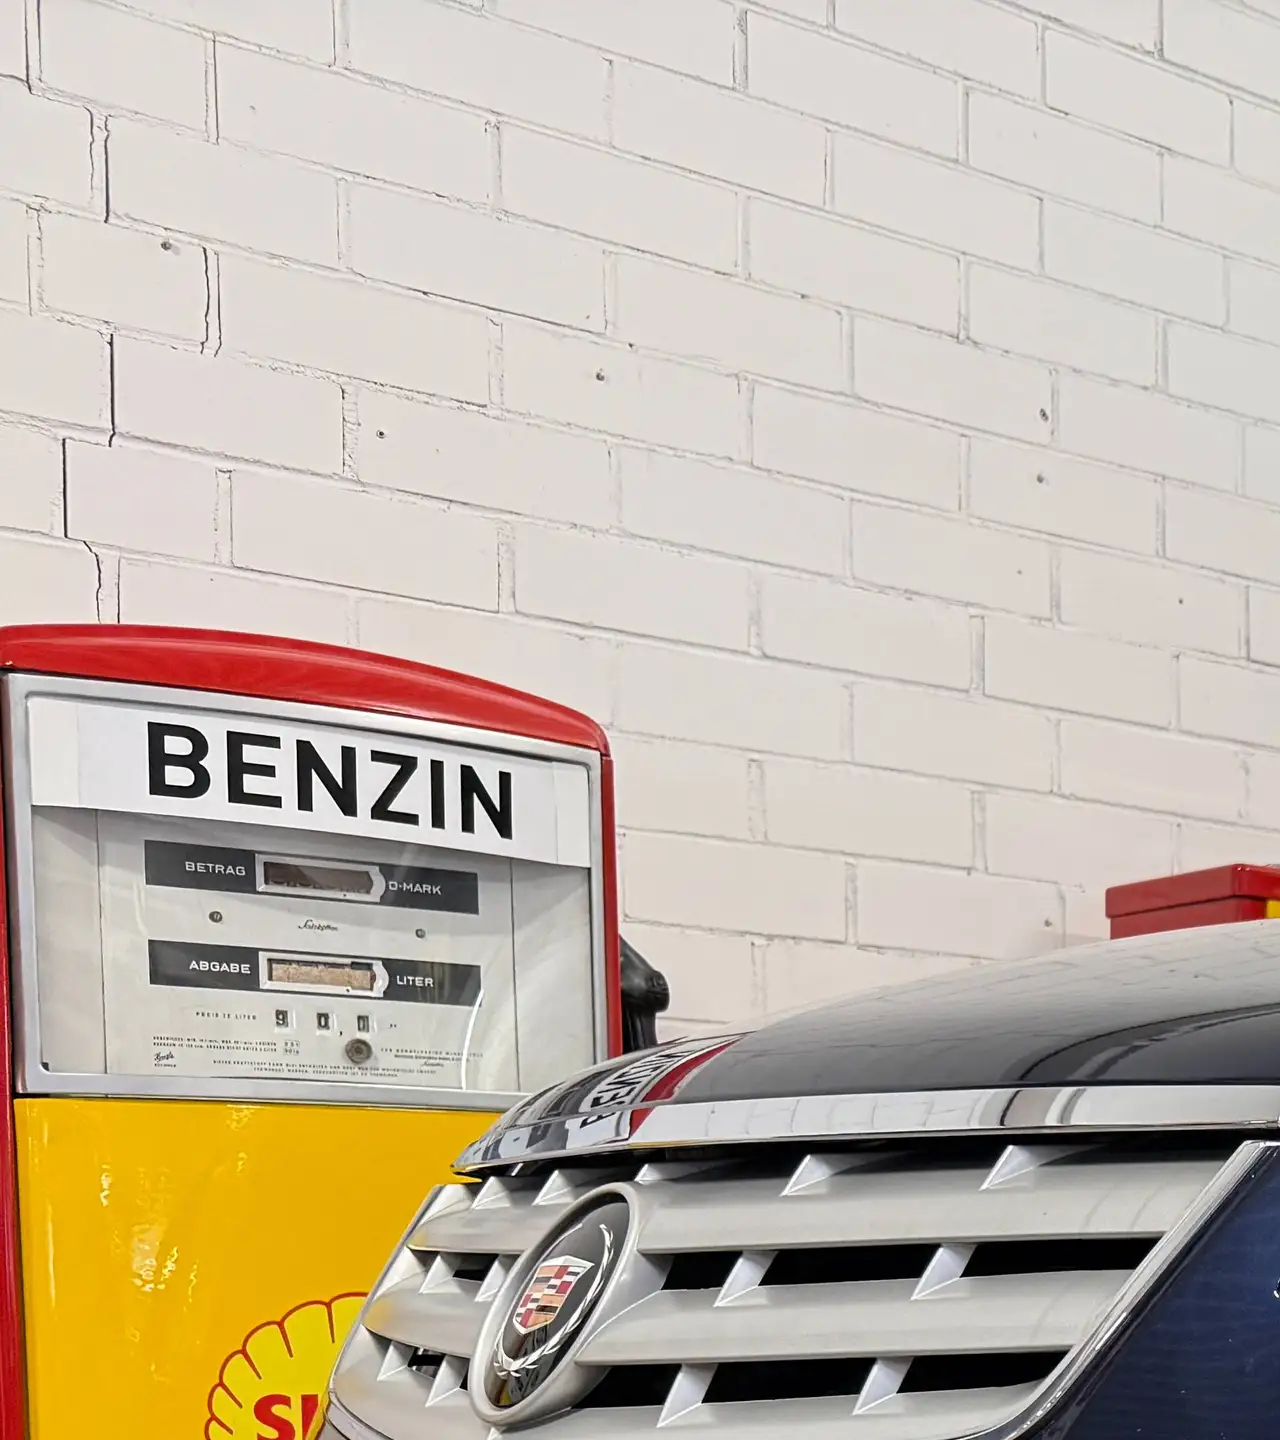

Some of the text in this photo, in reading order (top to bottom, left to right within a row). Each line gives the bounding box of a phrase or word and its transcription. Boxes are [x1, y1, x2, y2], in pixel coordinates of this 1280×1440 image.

[148, 722, 512, 840] BENZIN
[185, 860, 246, 876] BETRAG
[189, 960, 251, 974] ABGABE
[396, 975, 434, 988] LITER
